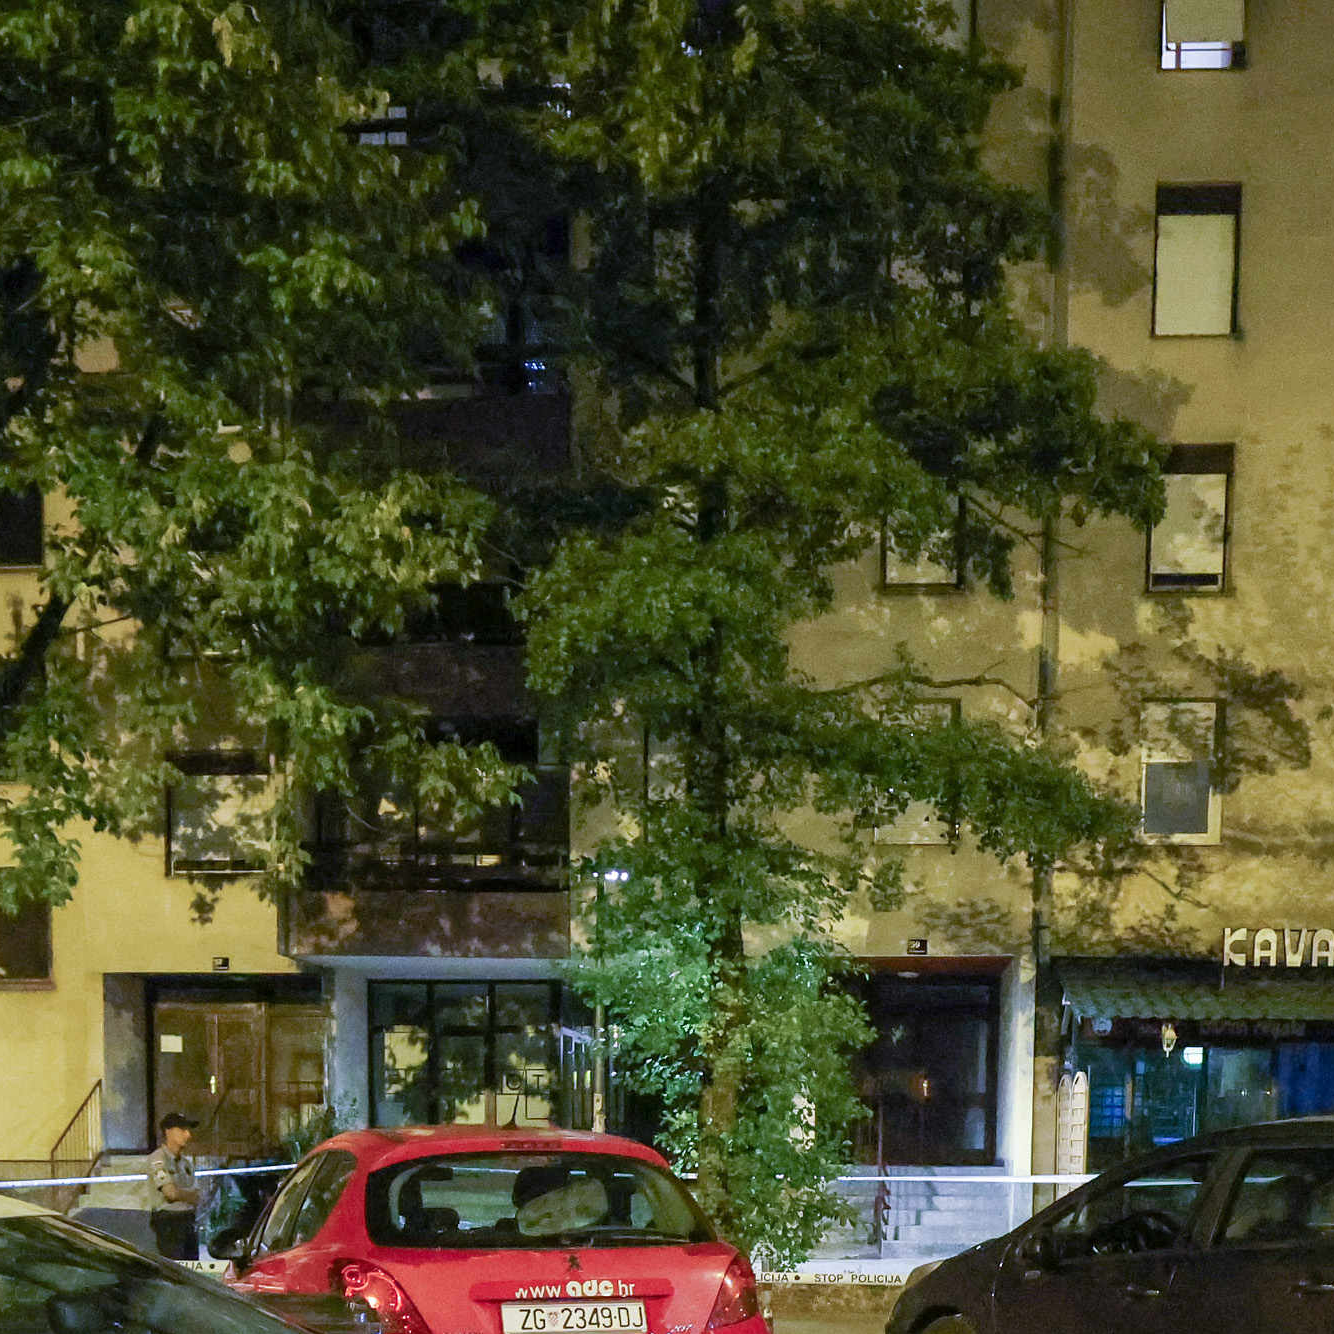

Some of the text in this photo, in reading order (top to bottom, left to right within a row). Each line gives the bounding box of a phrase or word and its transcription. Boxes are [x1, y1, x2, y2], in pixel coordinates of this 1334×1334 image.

[814, 1273, 902, 1284] STOP POLICIJA
[519, 1308, 546, 1331] ZG
